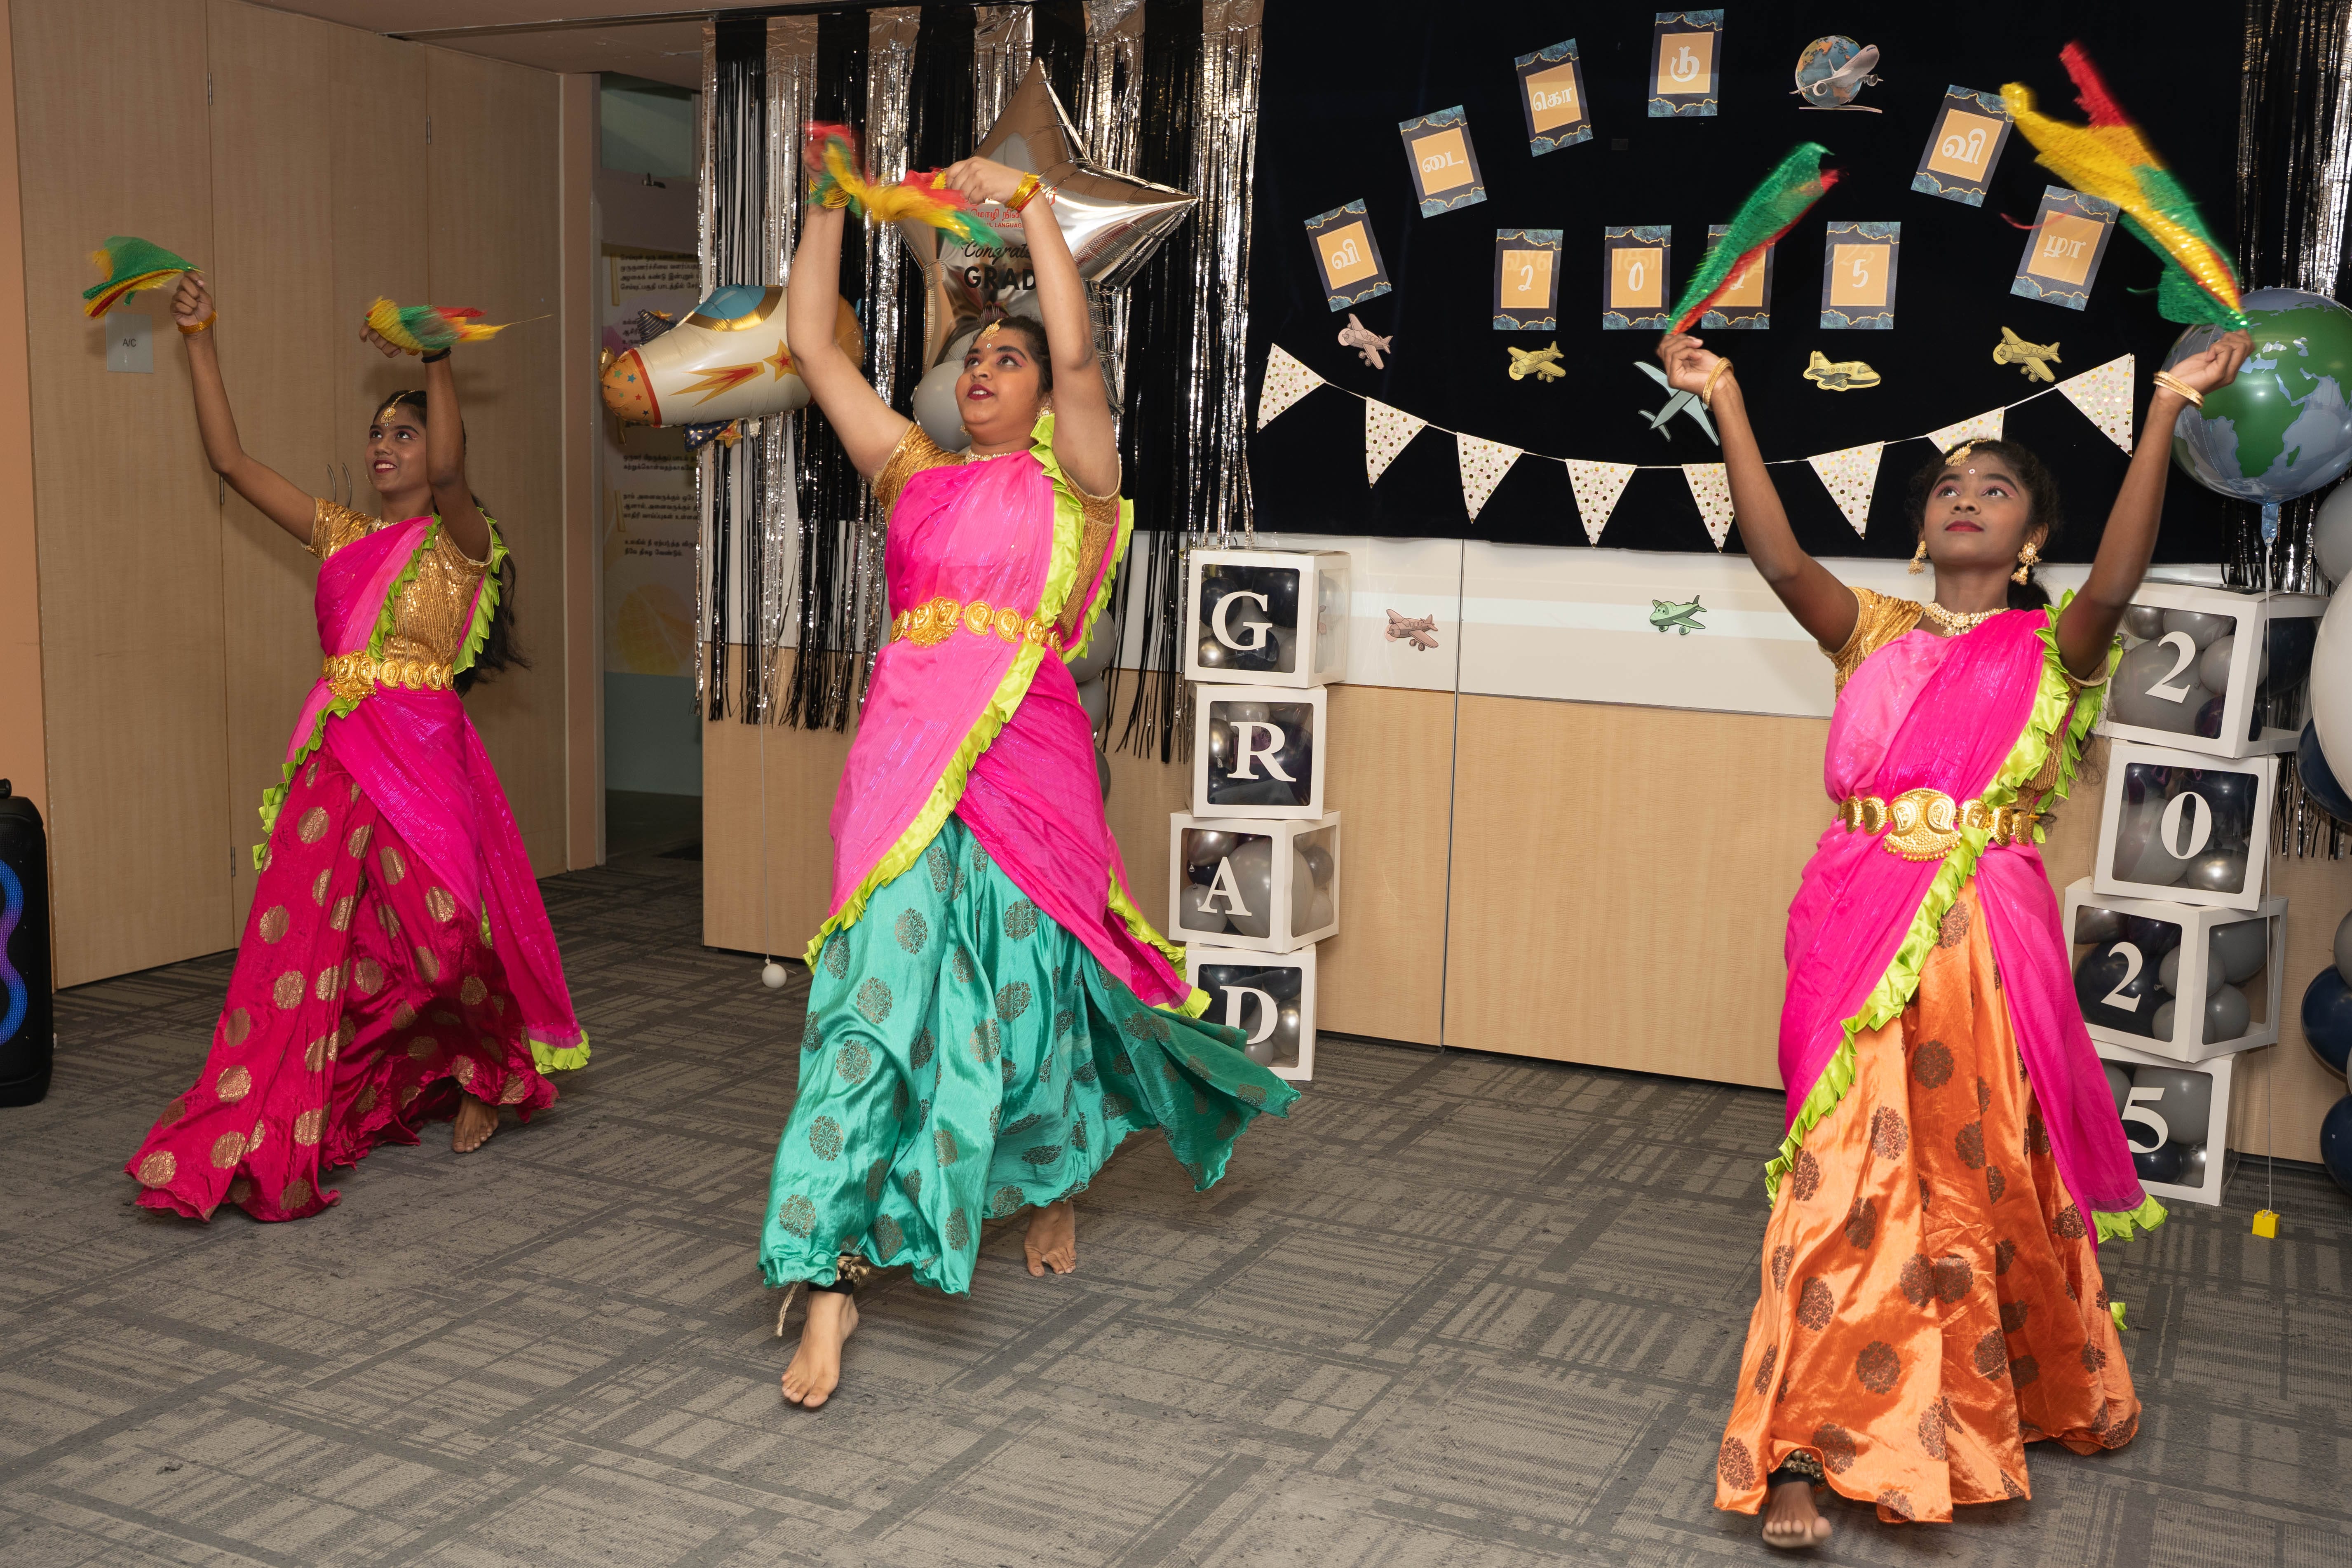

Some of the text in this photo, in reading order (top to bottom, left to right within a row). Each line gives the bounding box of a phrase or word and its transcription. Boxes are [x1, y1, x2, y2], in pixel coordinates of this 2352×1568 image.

[1331, 238, 1361, 269] வி
[1422, 151, 1464, 173] டை
[1533, 86, 1572, 111] கொ
[1942, 128, 2087, 258] வி ழா
[964, 266, 1036, 291] GRAD
[1519, 265, 1533, 291] 2
[1629, 262, 1643, 291] 0
[1853, 259, 1868, 288] 5
[122, 338, 136, 347] A/C
[1197, 591, 1296, 1045] G R A D
[2101, 631, 2212, 1153] 2 0 2 5
